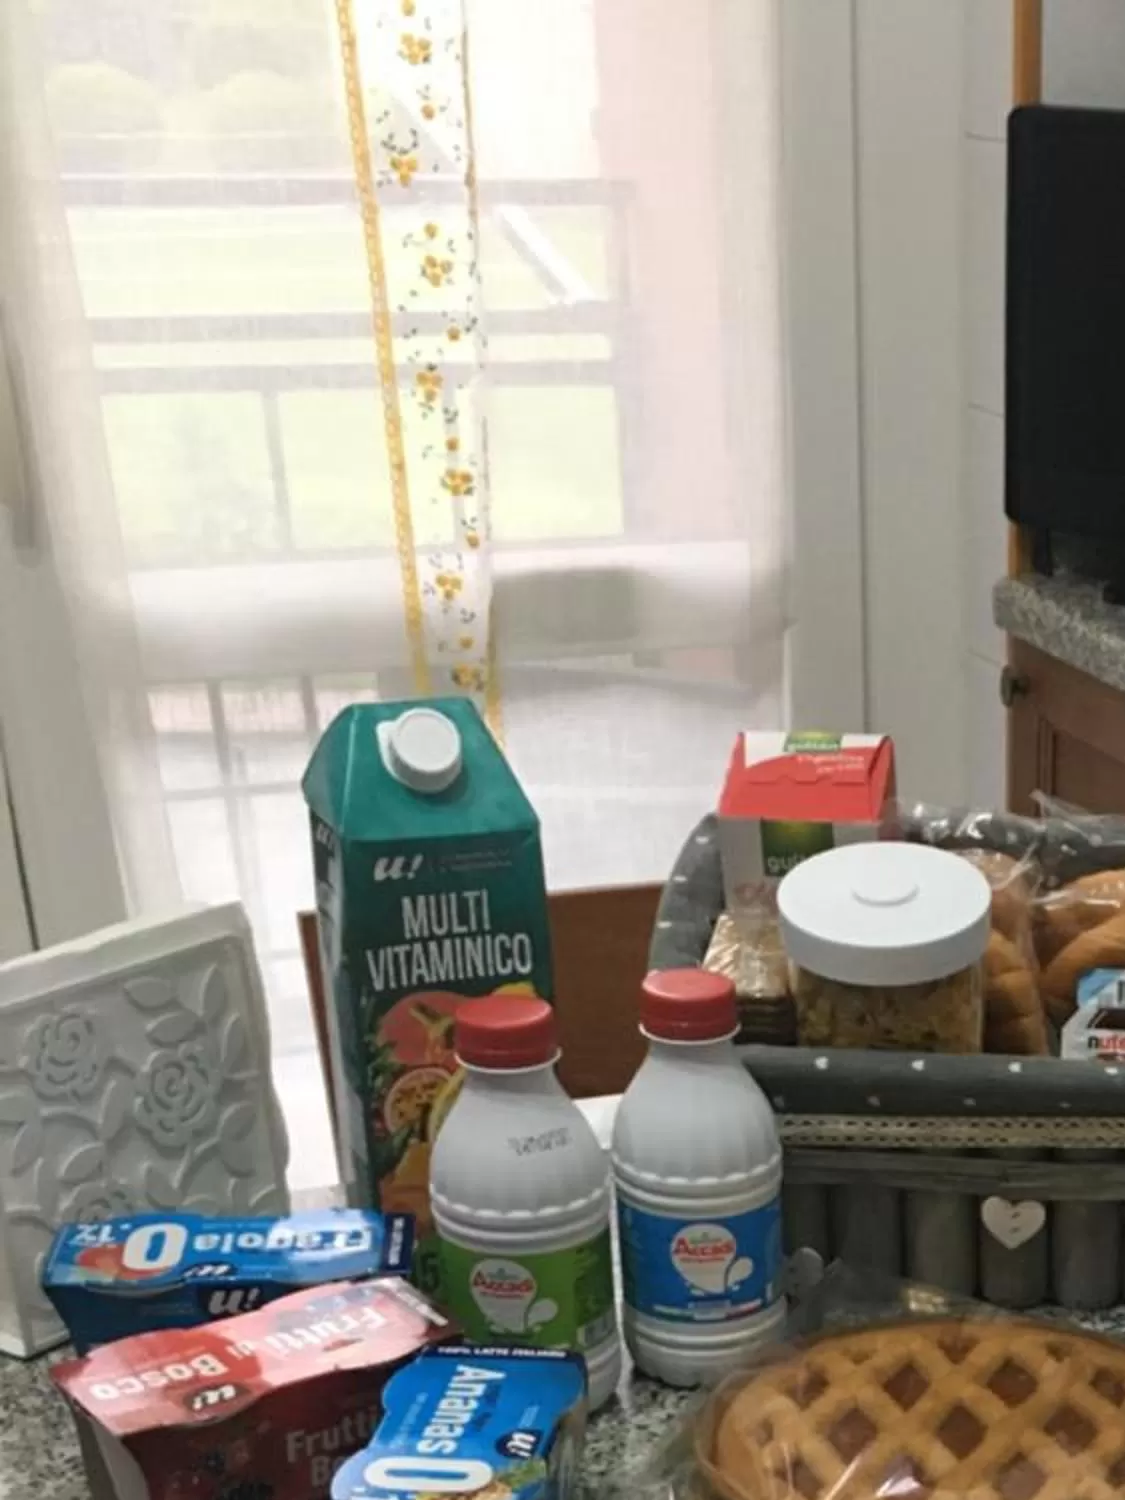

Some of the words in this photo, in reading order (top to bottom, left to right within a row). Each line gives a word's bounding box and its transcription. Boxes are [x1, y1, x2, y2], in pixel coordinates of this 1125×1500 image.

[402, 888, 491, 940] MULTI
[366, 933, 533, 991] VITAMINICO
[194, 1226, 374, 1252] Fragola
[266, 1305, 388, 1357] Frutti
[88, 1352, 231, 1401] Bosco
[415, 1363, 507, 1456] Ananas
